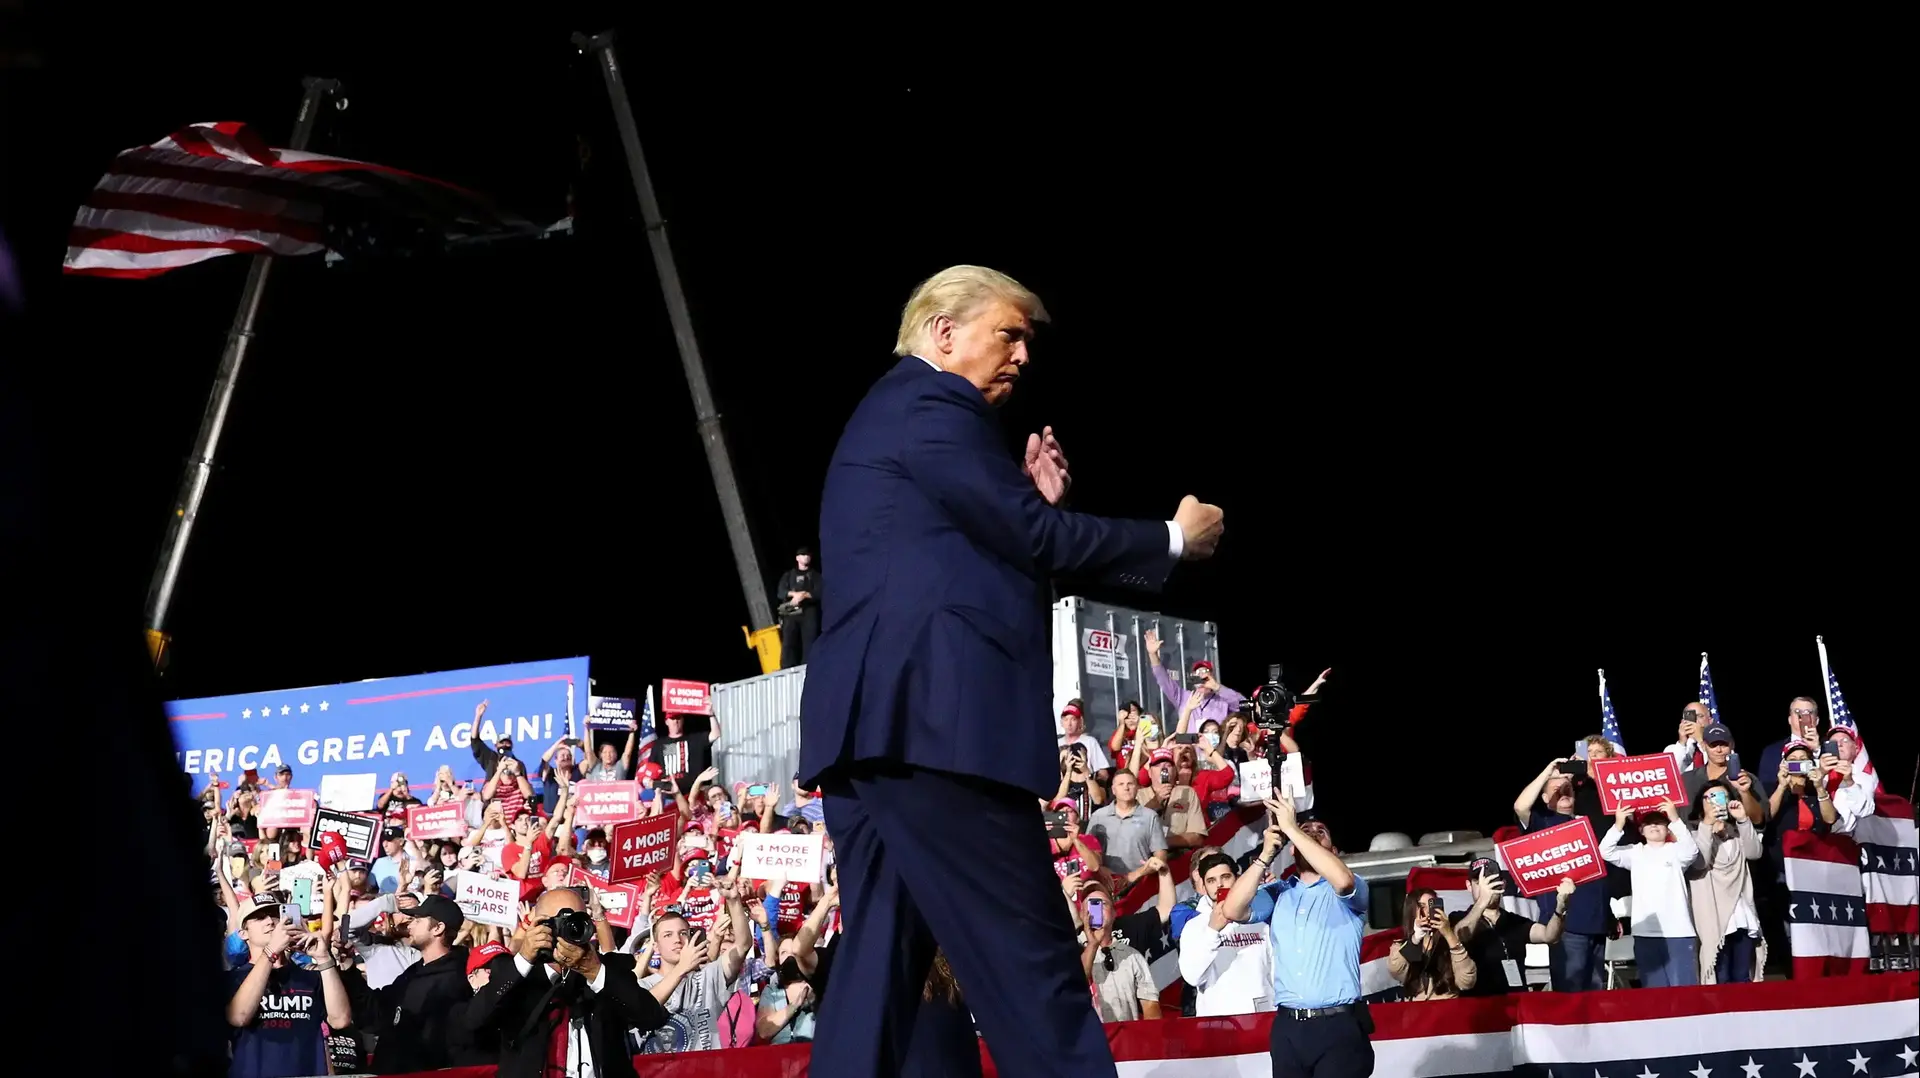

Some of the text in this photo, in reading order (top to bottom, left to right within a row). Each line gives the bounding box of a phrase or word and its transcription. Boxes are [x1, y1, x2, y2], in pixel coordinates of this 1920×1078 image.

[669, 688, 704, 698] 4 MORE
[602, 702, 622, 710] MAKE
[669, 697, 703, 707] YEARS!
[590, 708, 633, 719] AMERICA
[176, 713, 553, 774] ERICA GREAT AGAIN!
[1606, 768, 1668, 785] 4 MORE
[583, 791, 630, 803] 4 MORE
[1610, 783, 1671, 801] YEARS!
[415, 809, 457, 822] 4 MORE
[583, 803, 629, 815] YEARS!
[622, 828, 671, 851] 4 MORE
[757, 843, 809, 854] 4 MORE
[1514, 839, 1589, 869] PEACEFUL
[623, 846, 669, 869] YEARS!
[756, 856, 808, 868] YEARS!
[1522, 854, 1593, 882] PROTESTER
[466, 885, 510, 901] 4 MORE
[260, 994, 313, 1011] RUMP
